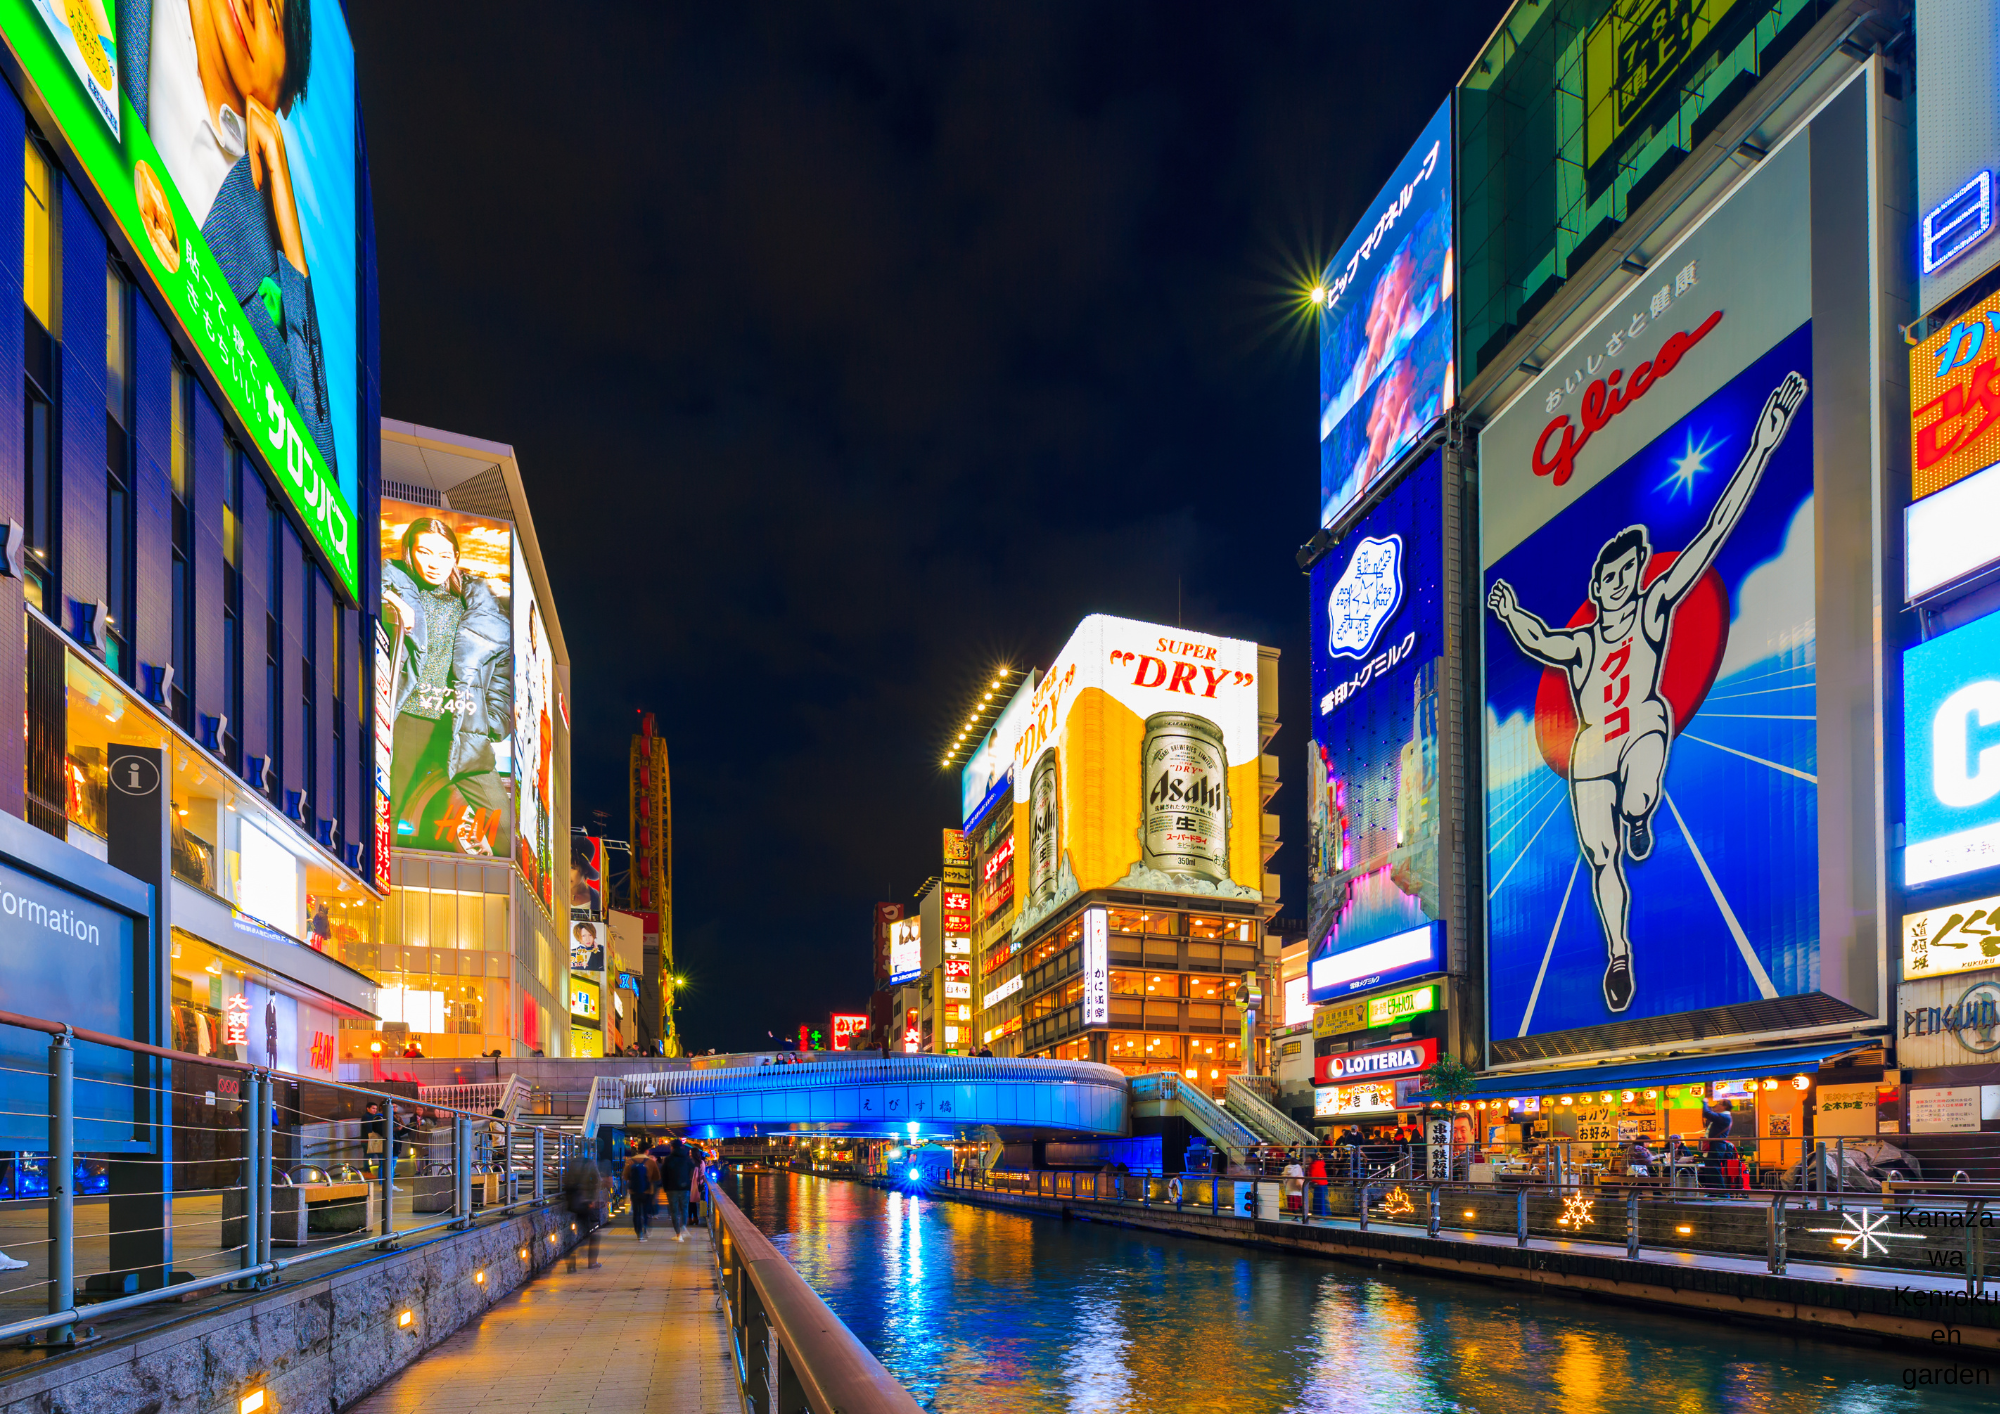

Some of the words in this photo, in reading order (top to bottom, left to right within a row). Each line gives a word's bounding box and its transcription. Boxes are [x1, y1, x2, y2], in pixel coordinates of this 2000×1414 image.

[1545, 260, 1698, 413] おいしさと健康
[187, 279, 262, 423] きもちいい。
[265, 382, 351, 571] サロンパス
[1156, 637, 1218, 661] SUPER
[1320, 631, 1415, 716] 雪印メグミルク
[419, 683, 475, 700] ジャケット
[1600, 636, 1634, 744] グリコ
[419, 694, 478, 716] ¥7,499
[1149, 769, 1222, 813] Asahi
[434, 804, 502, 848] H&M
[1176, 816, 1198, 832] 生
[1166, 833, 1208, 845] スーパードライ
[1177, 856, 1197, 867] 350ml
[0, 880, 99, 946] ormation
[1961, 958, 1996, 968] KUKURU
[1902, 999, 1997, 1040] PENGUIN
[310, 1031, 335, 1074] H&M
[1345, 1049, 1415, 1073] LOTTERIA
[863, 1098, 952, 1113] えびす橋
[1822, 1100, 1863, 1111] 金本知憲
[1579, 1125, 1611, 1140] お好み
